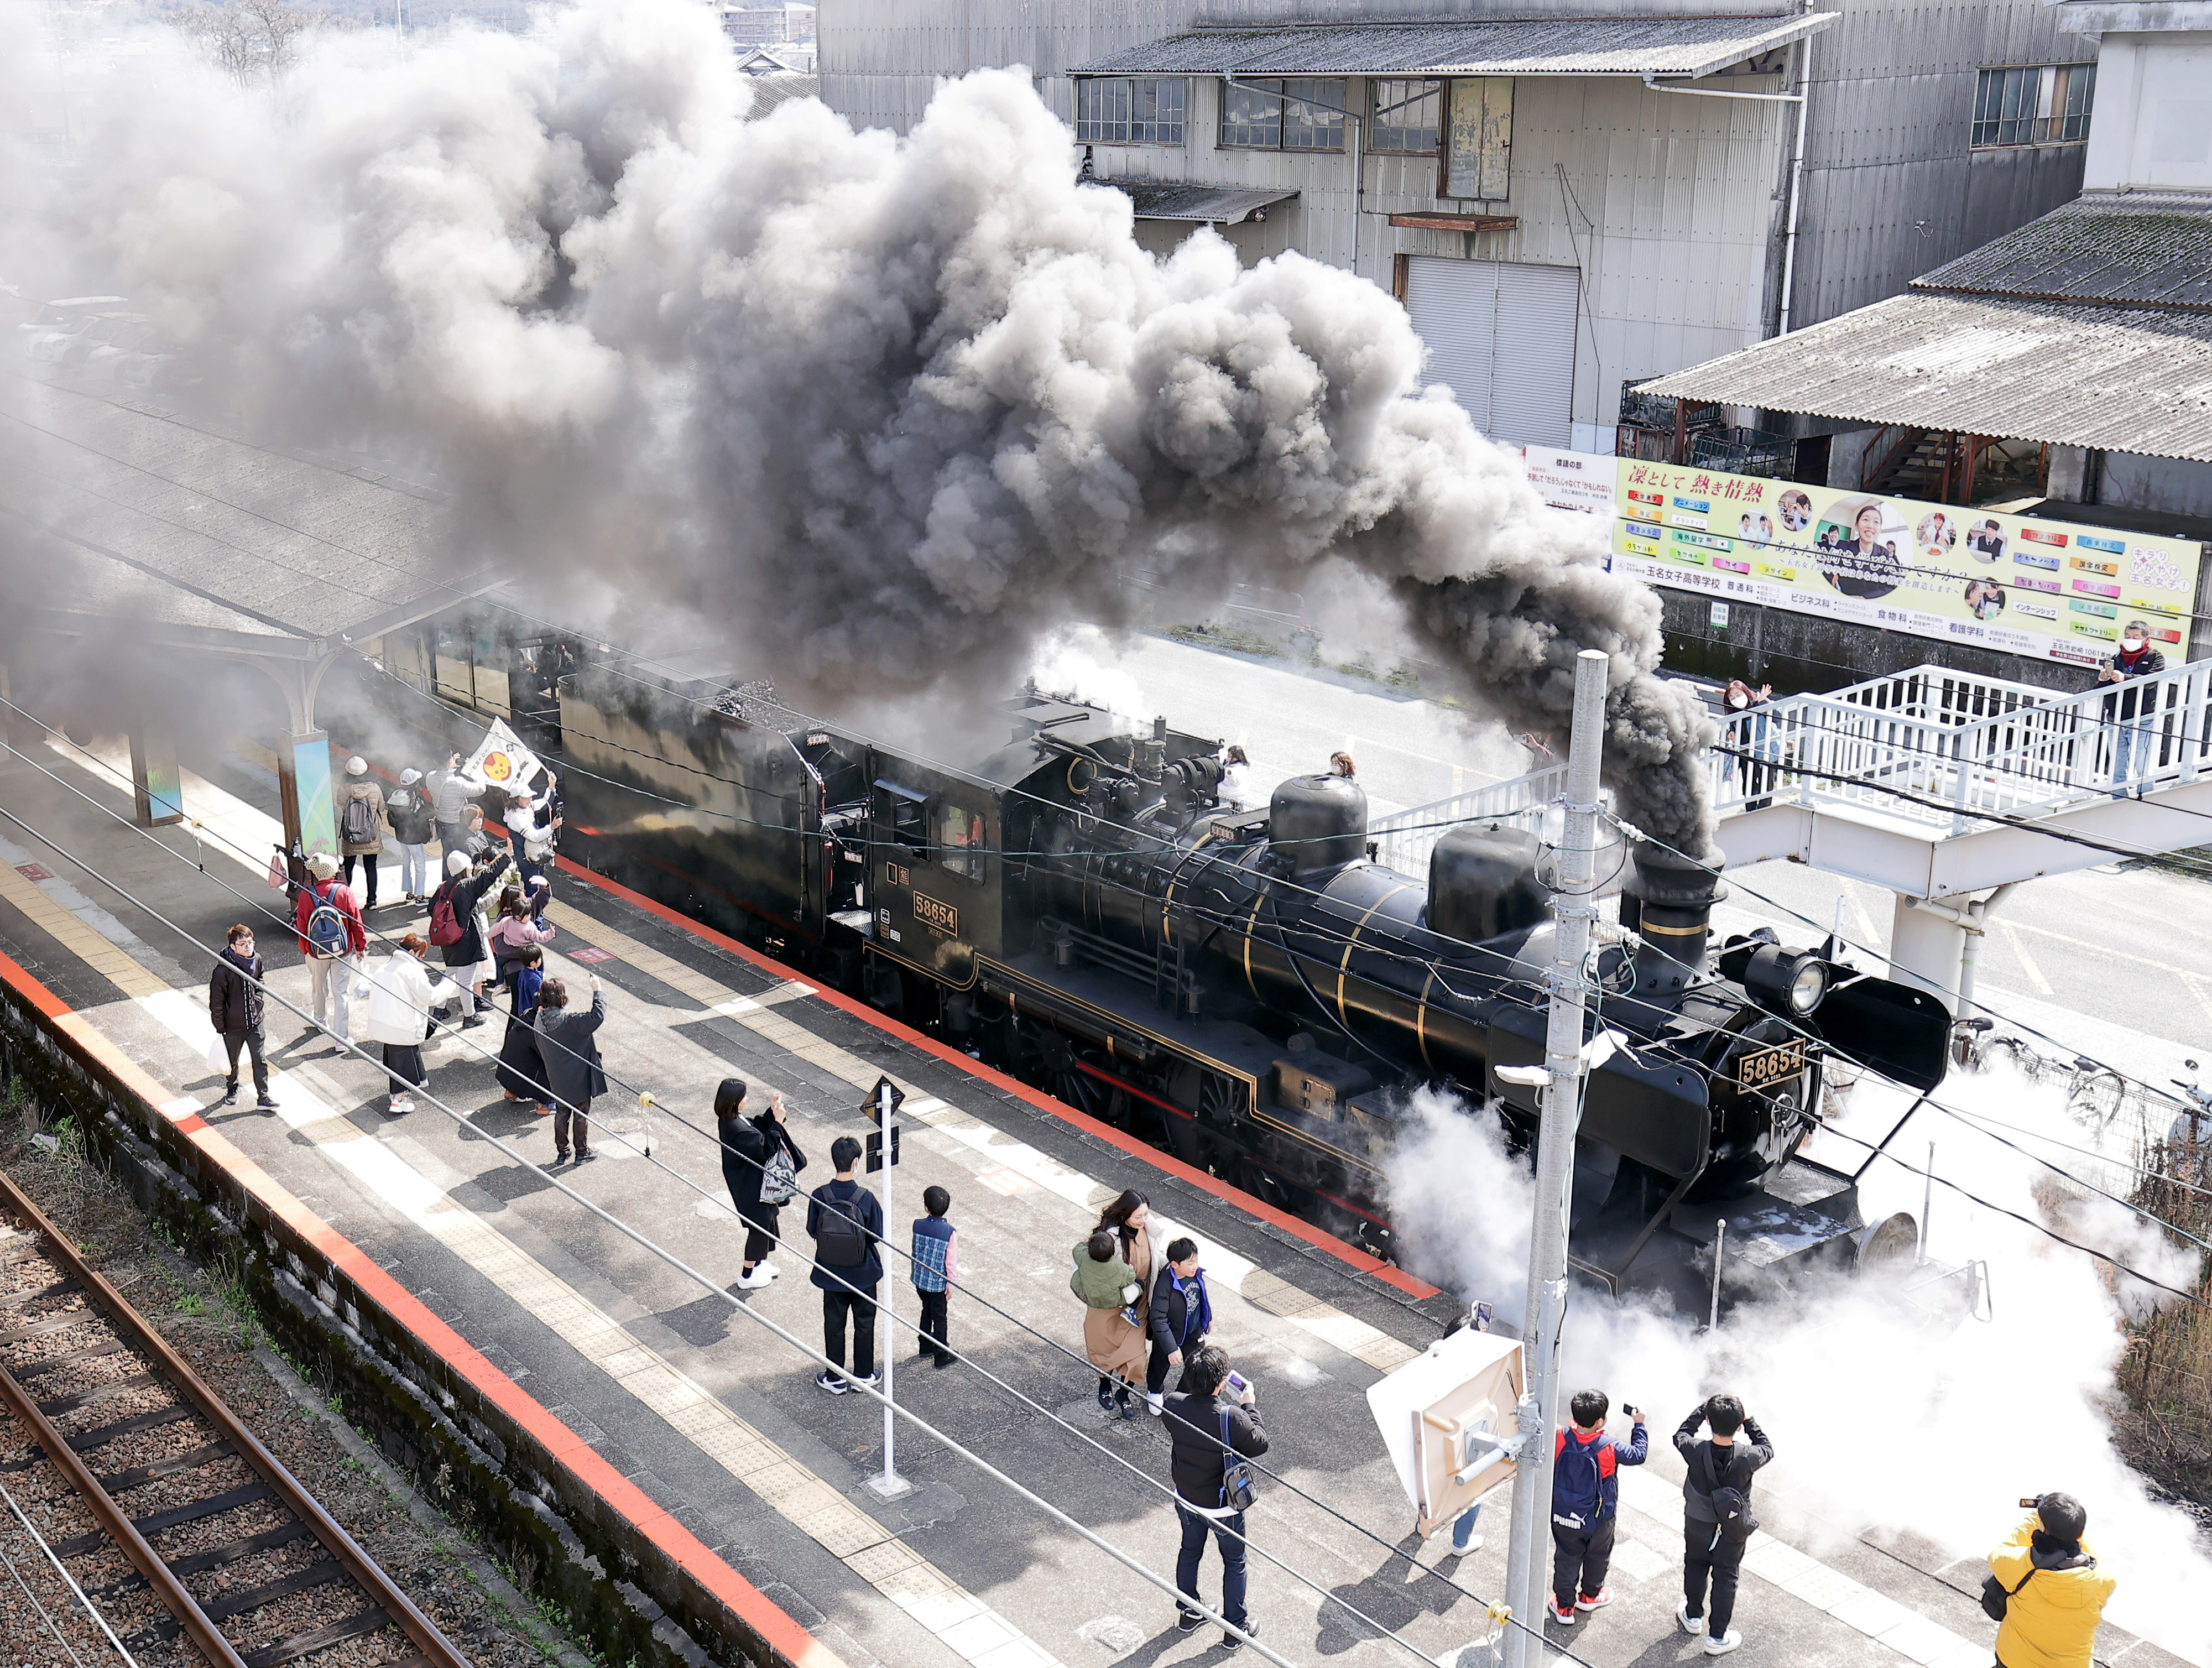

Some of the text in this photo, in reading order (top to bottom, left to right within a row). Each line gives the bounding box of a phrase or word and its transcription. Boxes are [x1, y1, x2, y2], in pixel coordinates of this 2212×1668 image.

[1556, 458, 1582, 470] 標語の部
[1628, 465, 1764, 503] 凛として 熱き情熱
[1675, 499, 1708, 509] アニメーション
[1676, 517, 1704, 527] ボランティア
[1677, 534, 1704, 544] 海外留学
[2086, 539, 2115, 550] 商業検定
[2135, 549, 2166, 561] キラリ
[1765, 567, 1787, 576] デザイン
[2079, 561, 2108, 572] 漢字検定
[2133, 561, 2179, 575] かがやけ
[1647, 566, 1720, 590] 玉名女子高等学校
[1728, 581, 1753, 594] 普通科
[2083, 583, 2110, 593] 修学旅行
[1791, 593, 1830, 608] ビジネス科
[2016, 604, 2056, 616] インターンシップ
[2079, 603, 2108, 614] 保育検定
[1877, 609, 1907, 623] 食物科
[1949, 623, 1984, 638] 看護学科
[900, 869, 909, 884] 熊
[916, 895, 954, 928] 58654
[1743, 1045, 1801, 1083] 58654
[1553, 1513, 1580, 1529] PUMA
